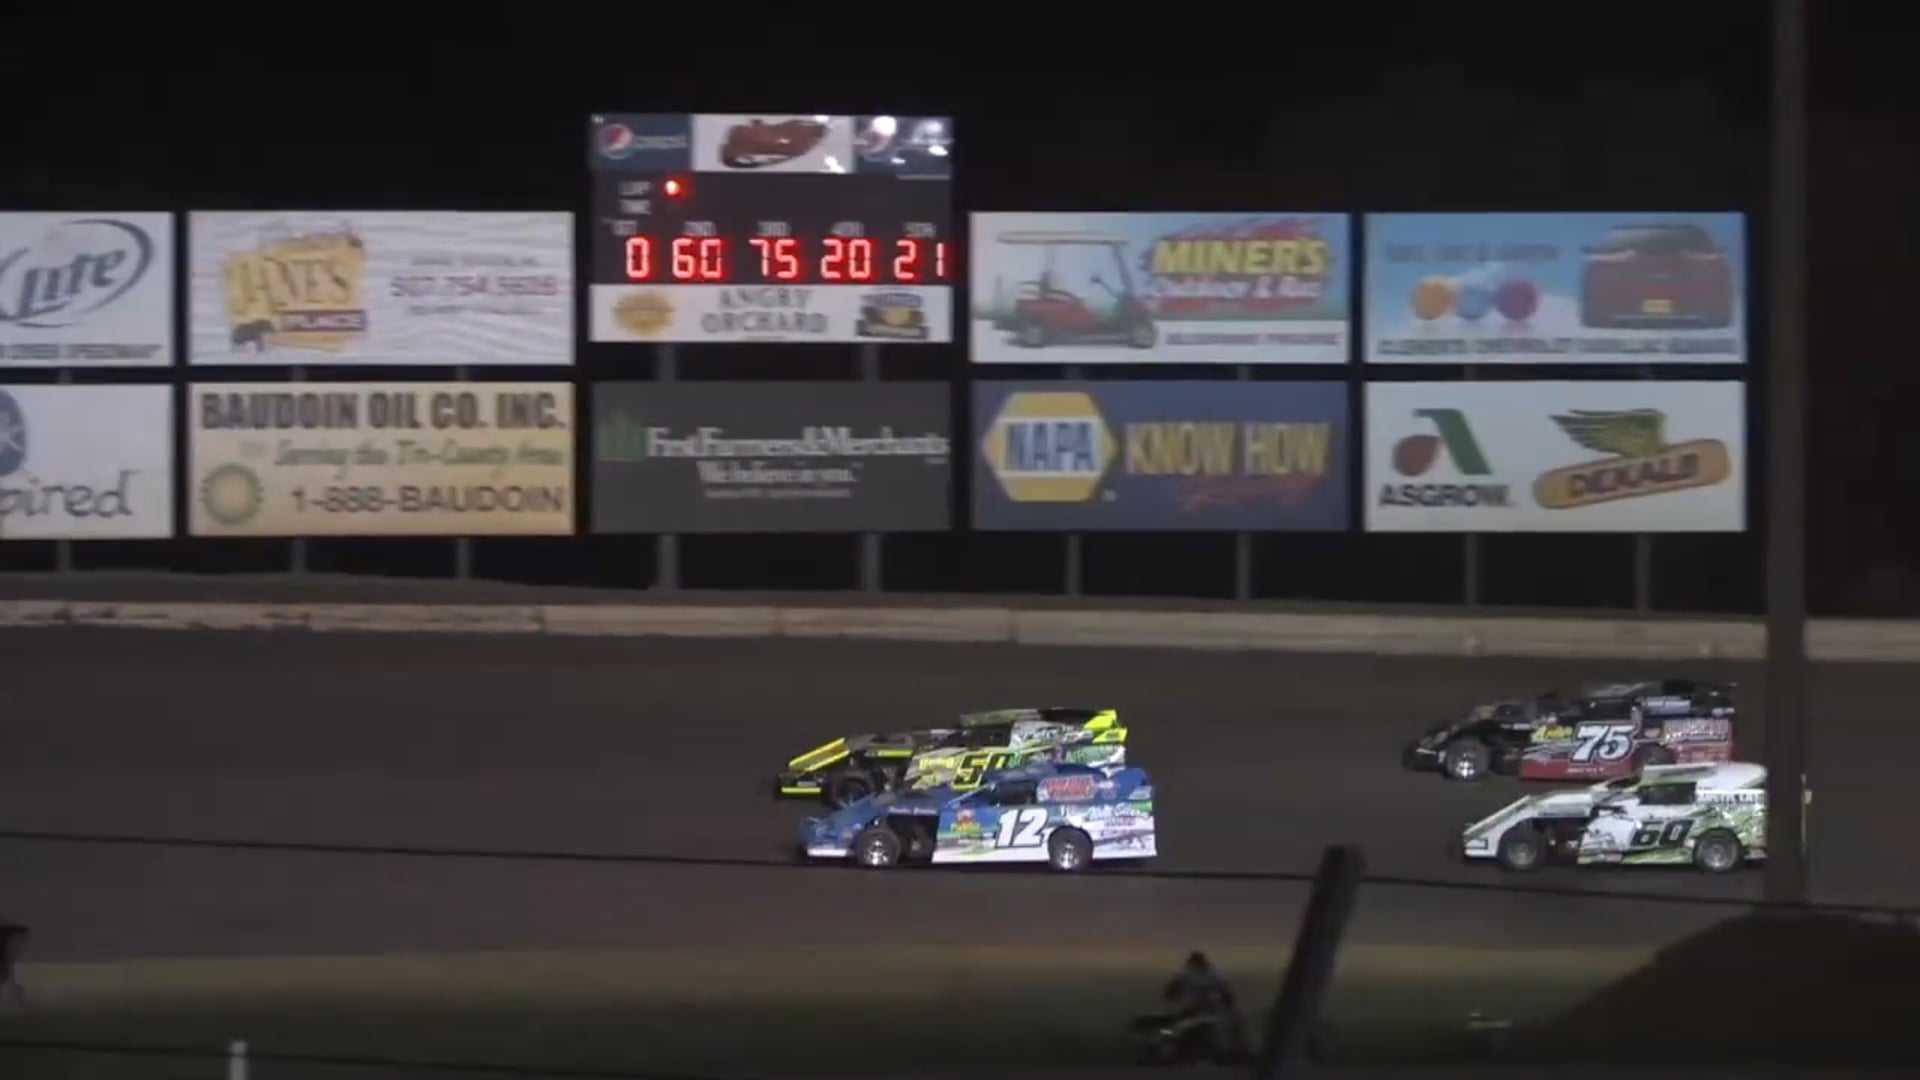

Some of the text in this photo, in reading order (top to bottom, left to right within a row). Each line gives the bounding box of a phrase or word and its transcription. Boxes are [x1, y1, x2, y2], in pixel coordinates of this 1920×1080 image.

[626, 237, 945, 279] 0 60 75 20 21
[716, 288, 812, 309] ANGRY
[701, 312, 829, 333] ORCHARD
[203, 392, 567, 429] BAUDOIN OIL CO. INC.
[1006, 421, 1331, 475] NAPA KNOW HOW
[291, 485, 565, 513] 1-888-BAUDOIN
[1571, 722, 1643, 763] 75
[995, 807, 1050, 848] 12
[1630, 818, 1694, 847] 60
